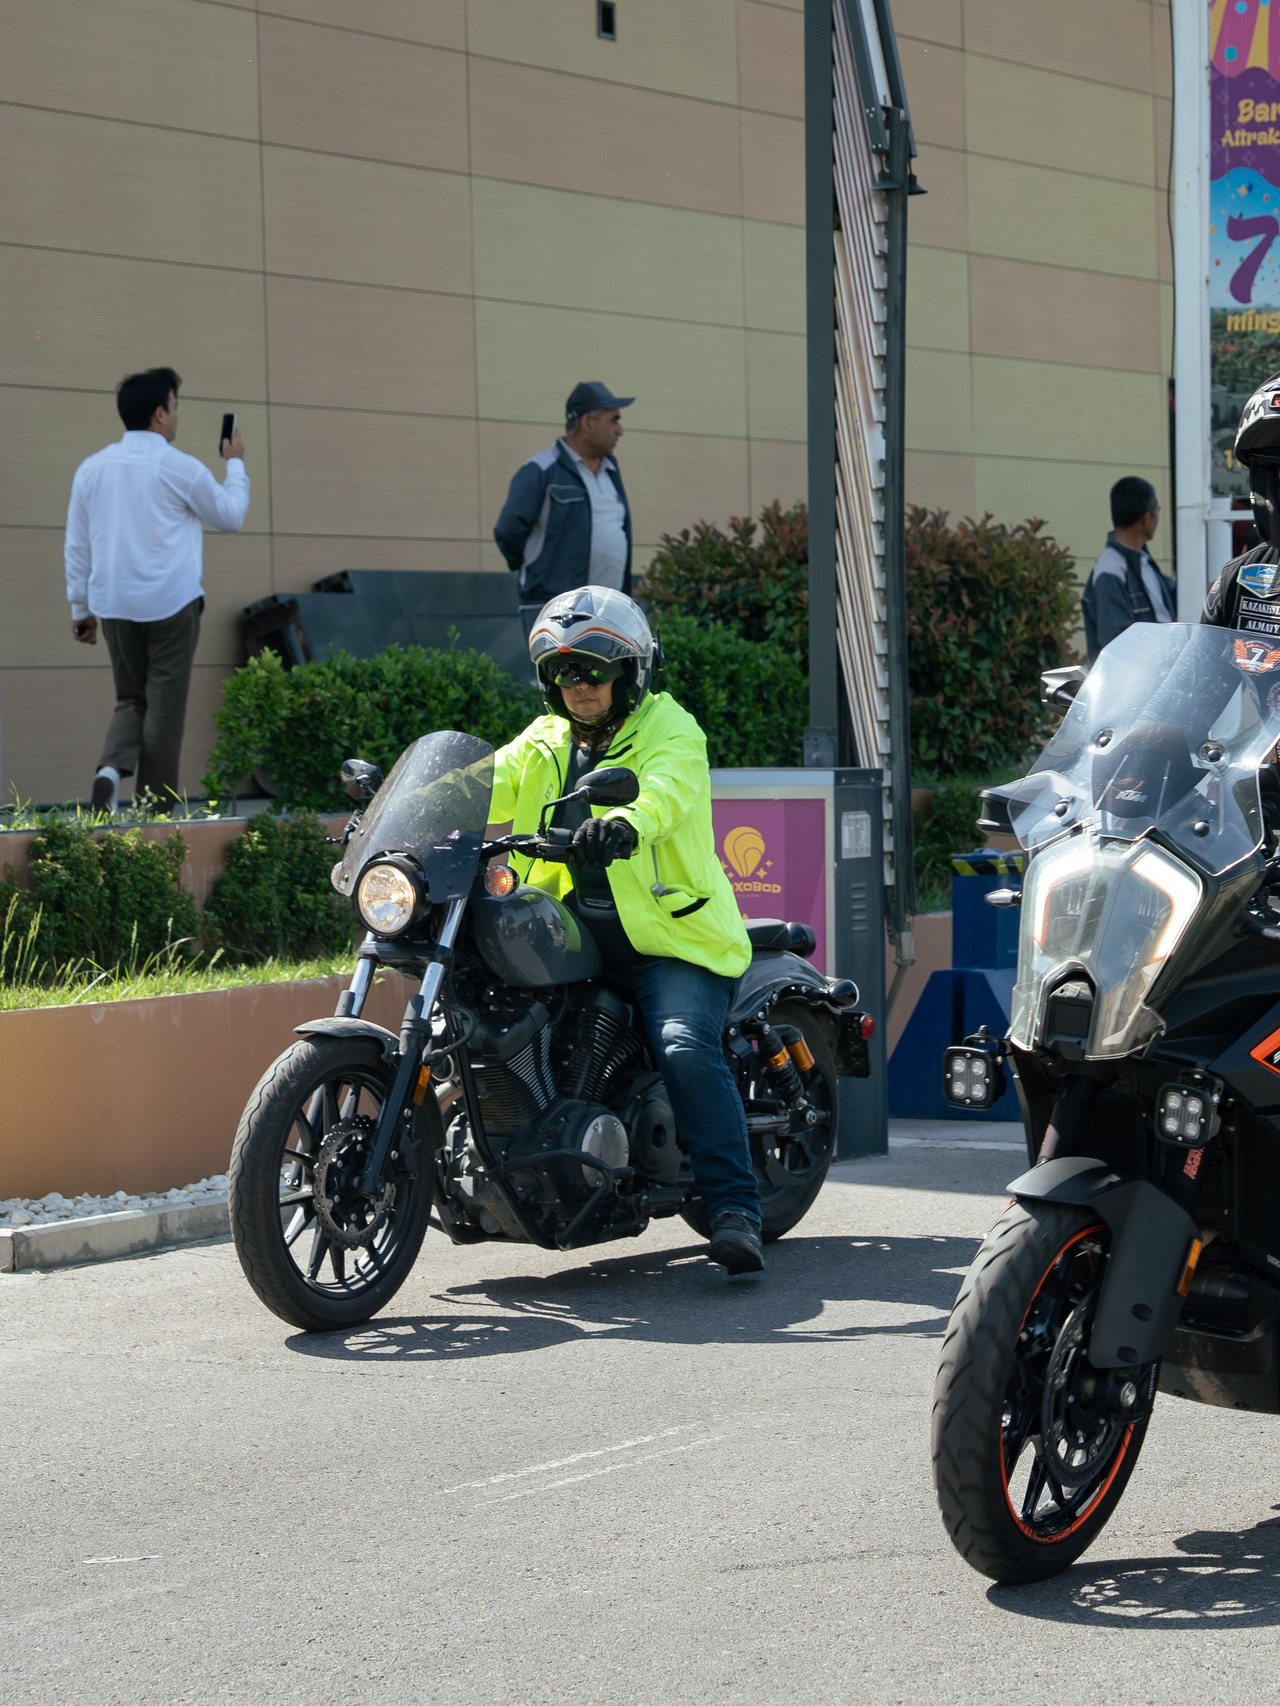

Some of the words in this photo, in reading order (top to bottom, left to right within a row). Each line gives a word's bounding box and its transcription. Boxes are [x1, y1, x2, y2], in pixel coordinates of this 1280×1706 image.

[1245, 620, 1280, 634] ALMATY
[1114, 789, 1148, 803] KTM
[731, 881, 782, 894] XOBOD
